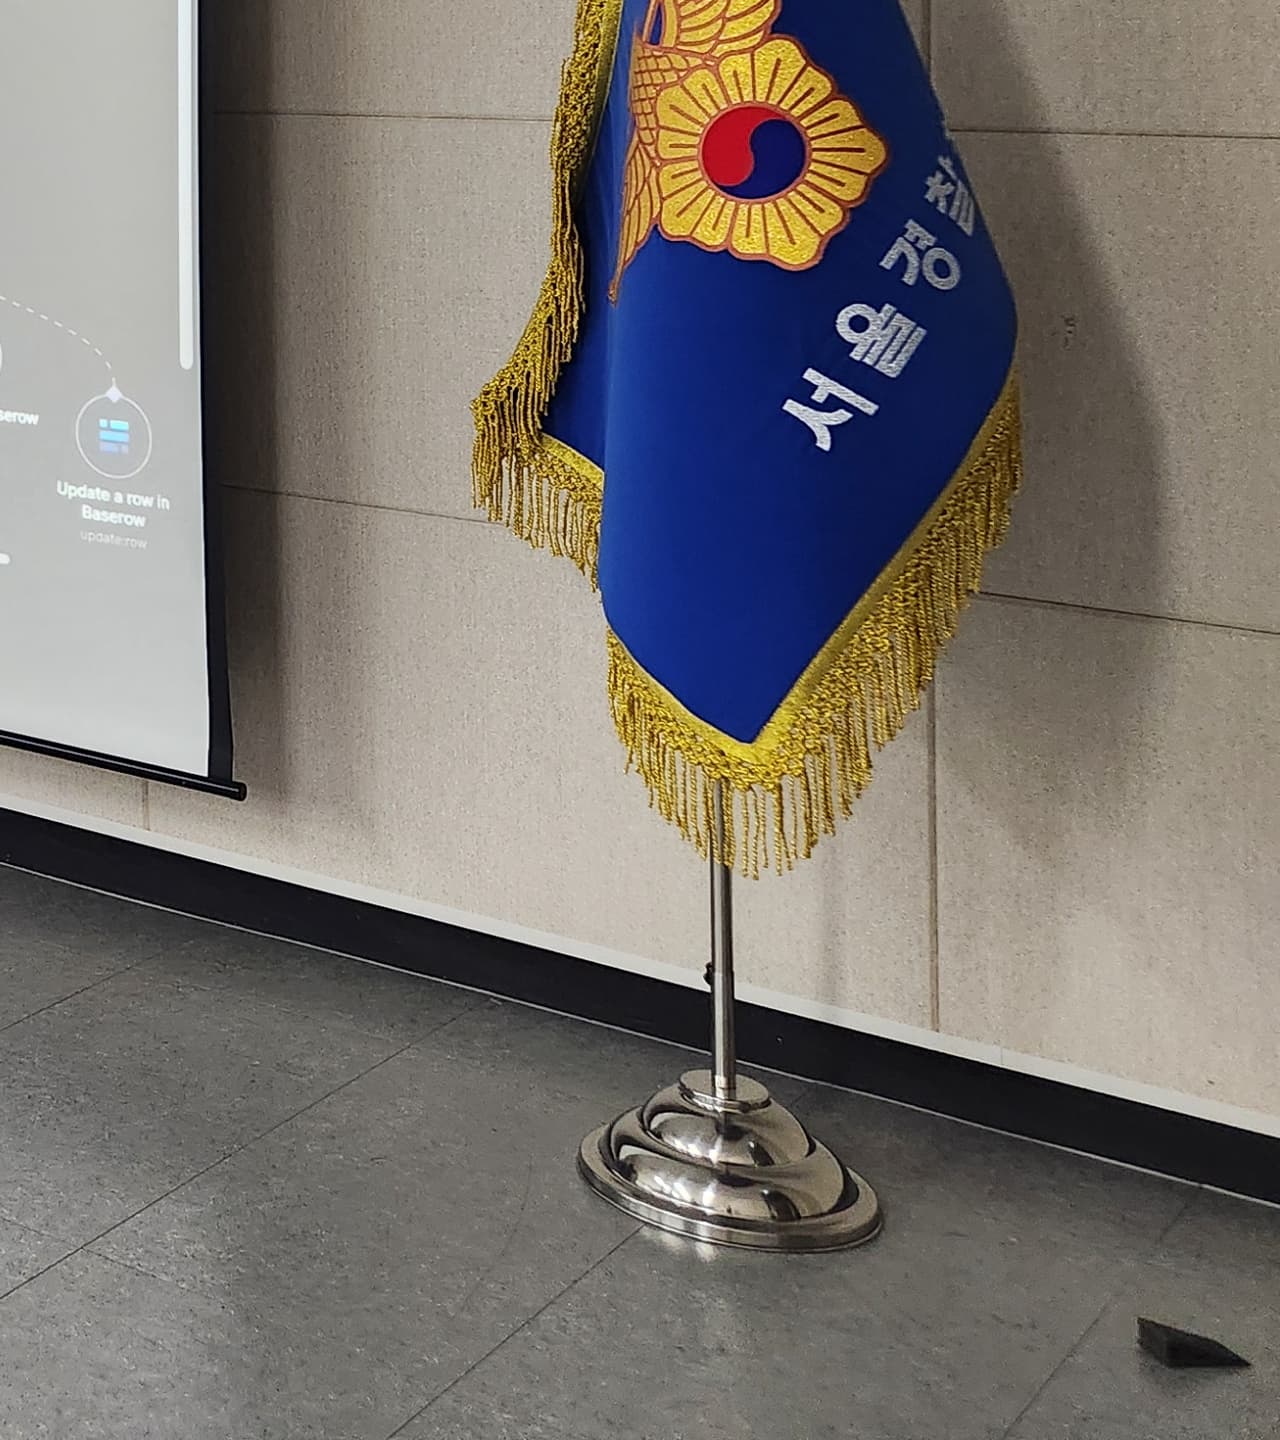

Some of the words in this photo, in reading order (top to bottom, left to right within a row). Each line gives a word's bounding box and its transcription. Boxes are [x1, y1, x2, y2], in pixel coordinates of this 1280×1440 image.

[56, 479, 111, 501] Update
[113, 491, 123, 504] a
[126, 492, 154, 508] row
[156, 493, 170, 511] in
[81, 503, 146, 527] Baserow
